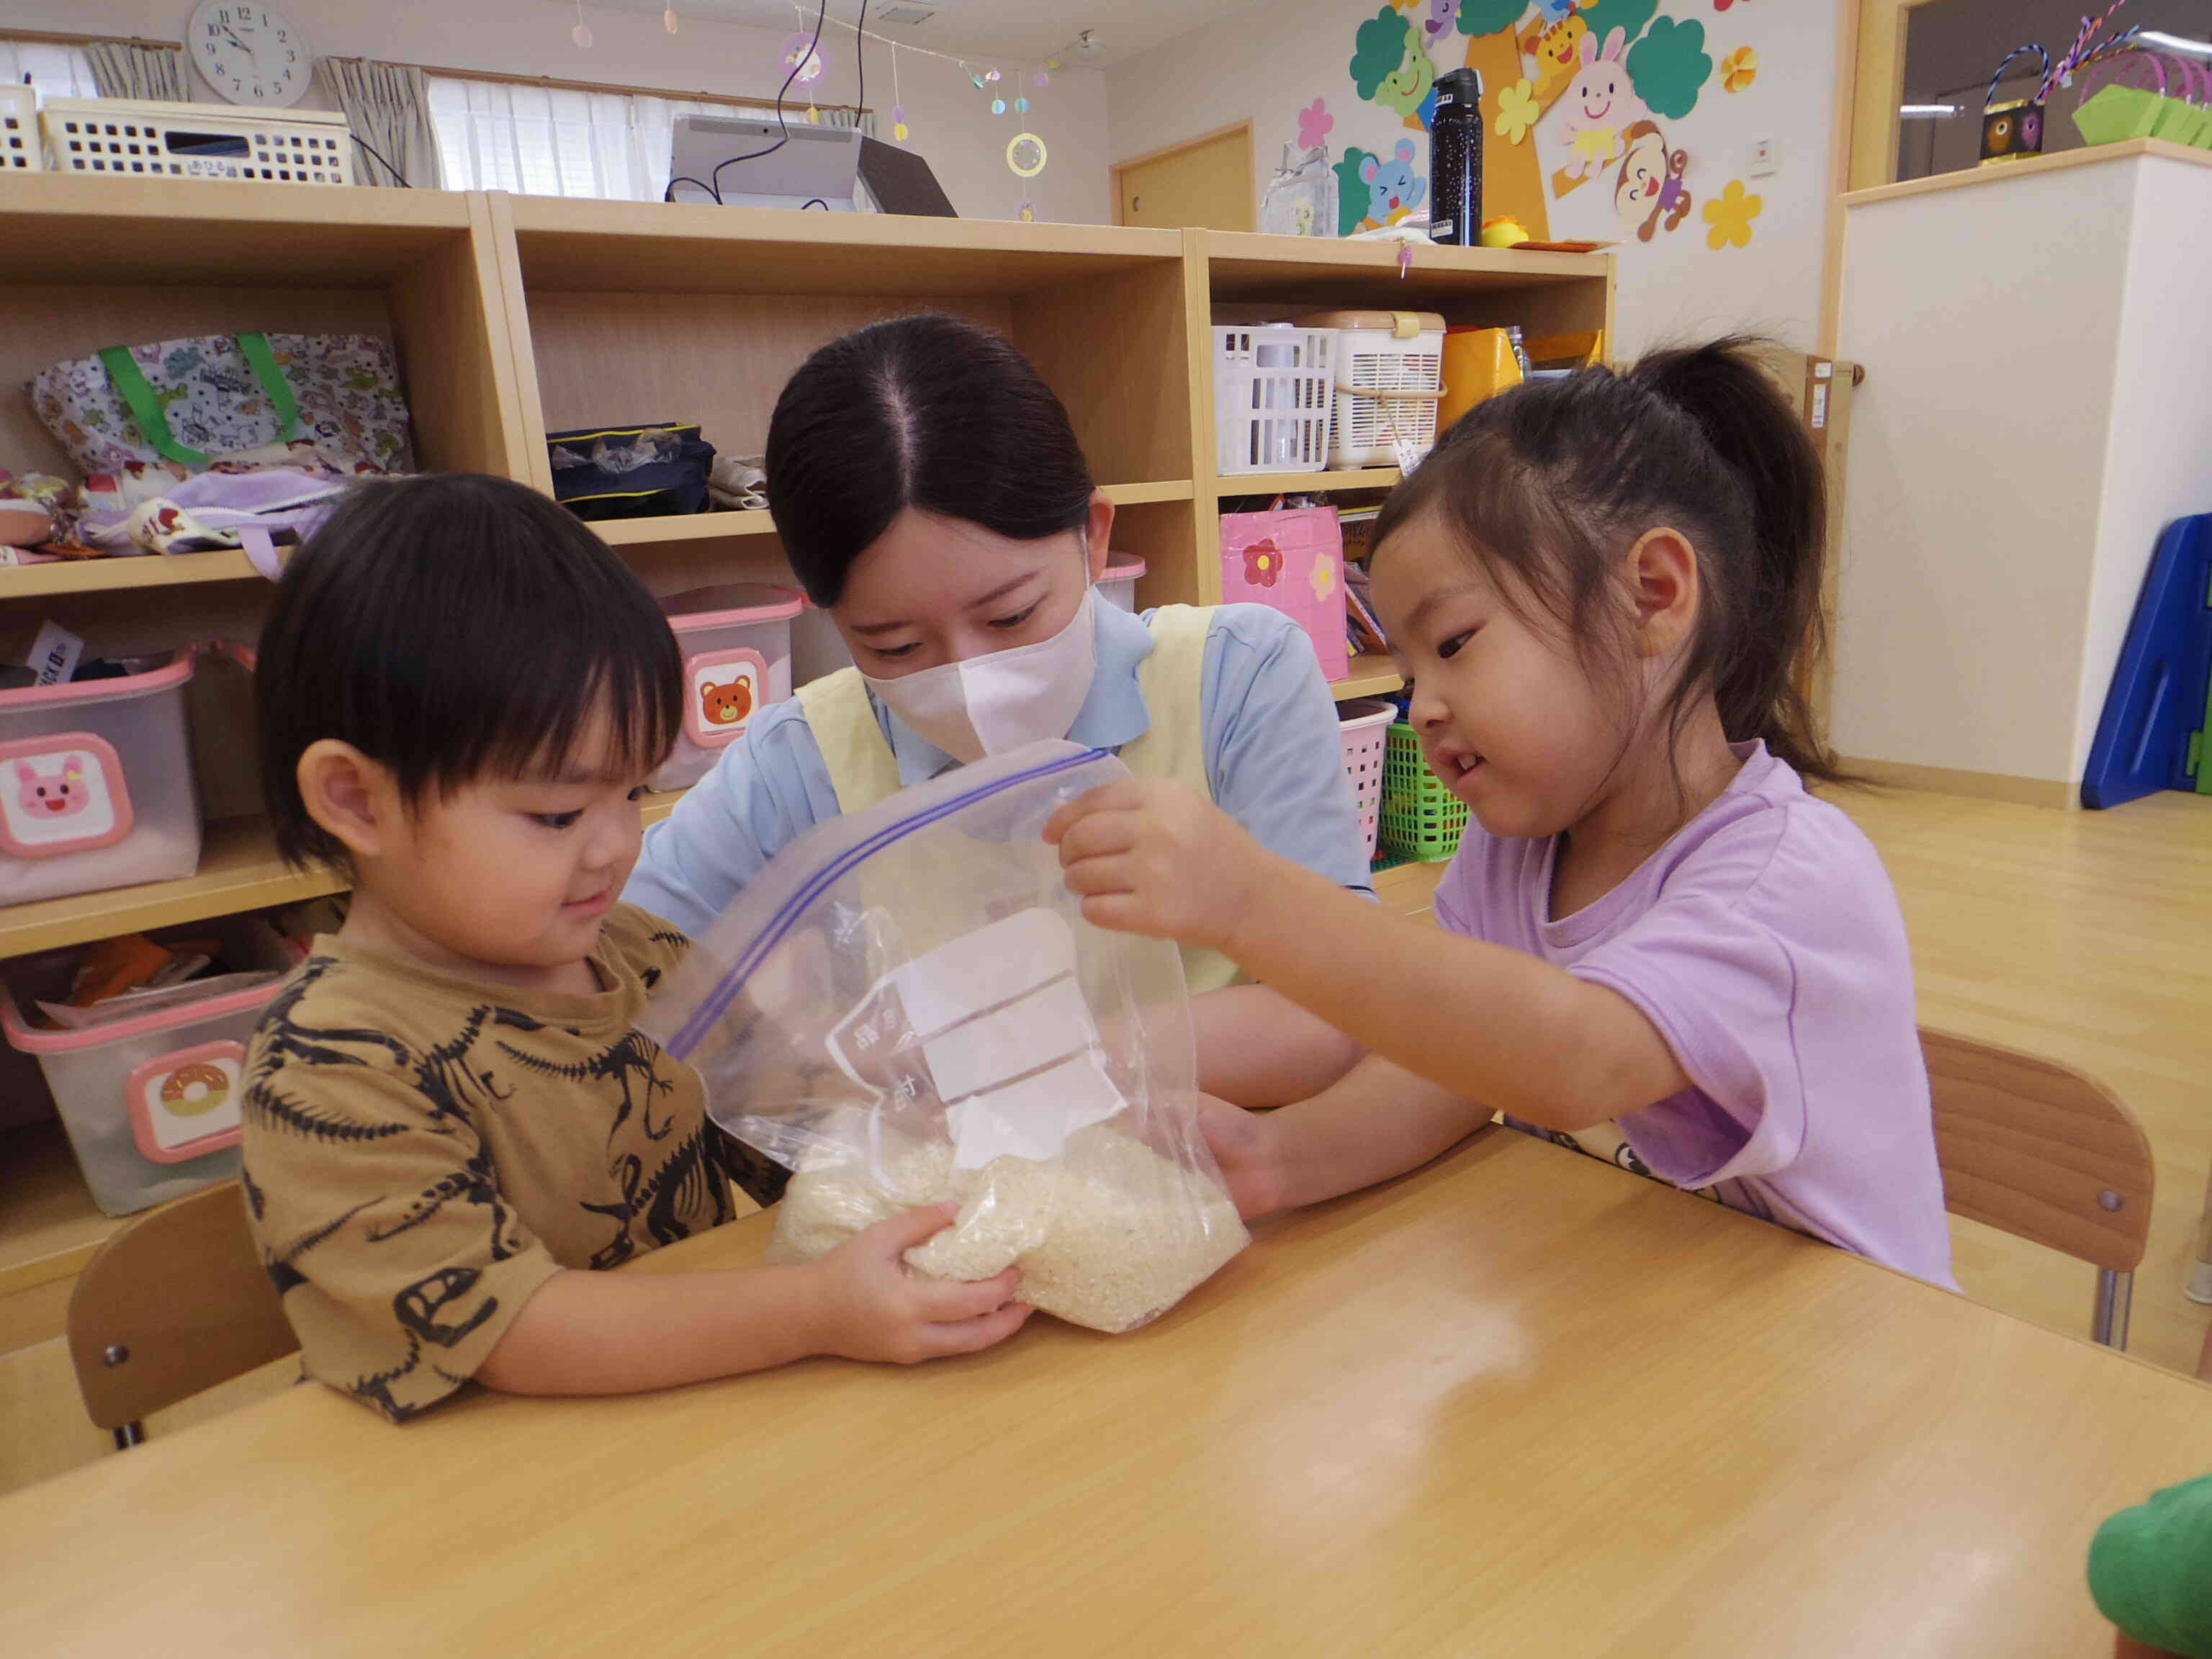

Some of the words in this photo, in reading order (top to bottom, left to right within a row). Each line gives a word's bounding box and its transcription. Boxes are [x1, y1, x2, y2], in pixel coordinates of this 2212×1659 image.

[219, 9, 230, 24] 11
[237, 6, 251, 21] 12
[207, 23, 220, 37] 10
[277, 30, 287, 43] 2
[206, 42, 215, 55] 9
[286, 50, 295, 63] 3
[215, 63, 225, 76] 8
[282, 68, 291, 81] 4
[233, 77, 241, 92] 7
[273, 81, 282, 95] 5
[253, 85, 264, 98] 6
[192, 160, 225, 171] あひる
